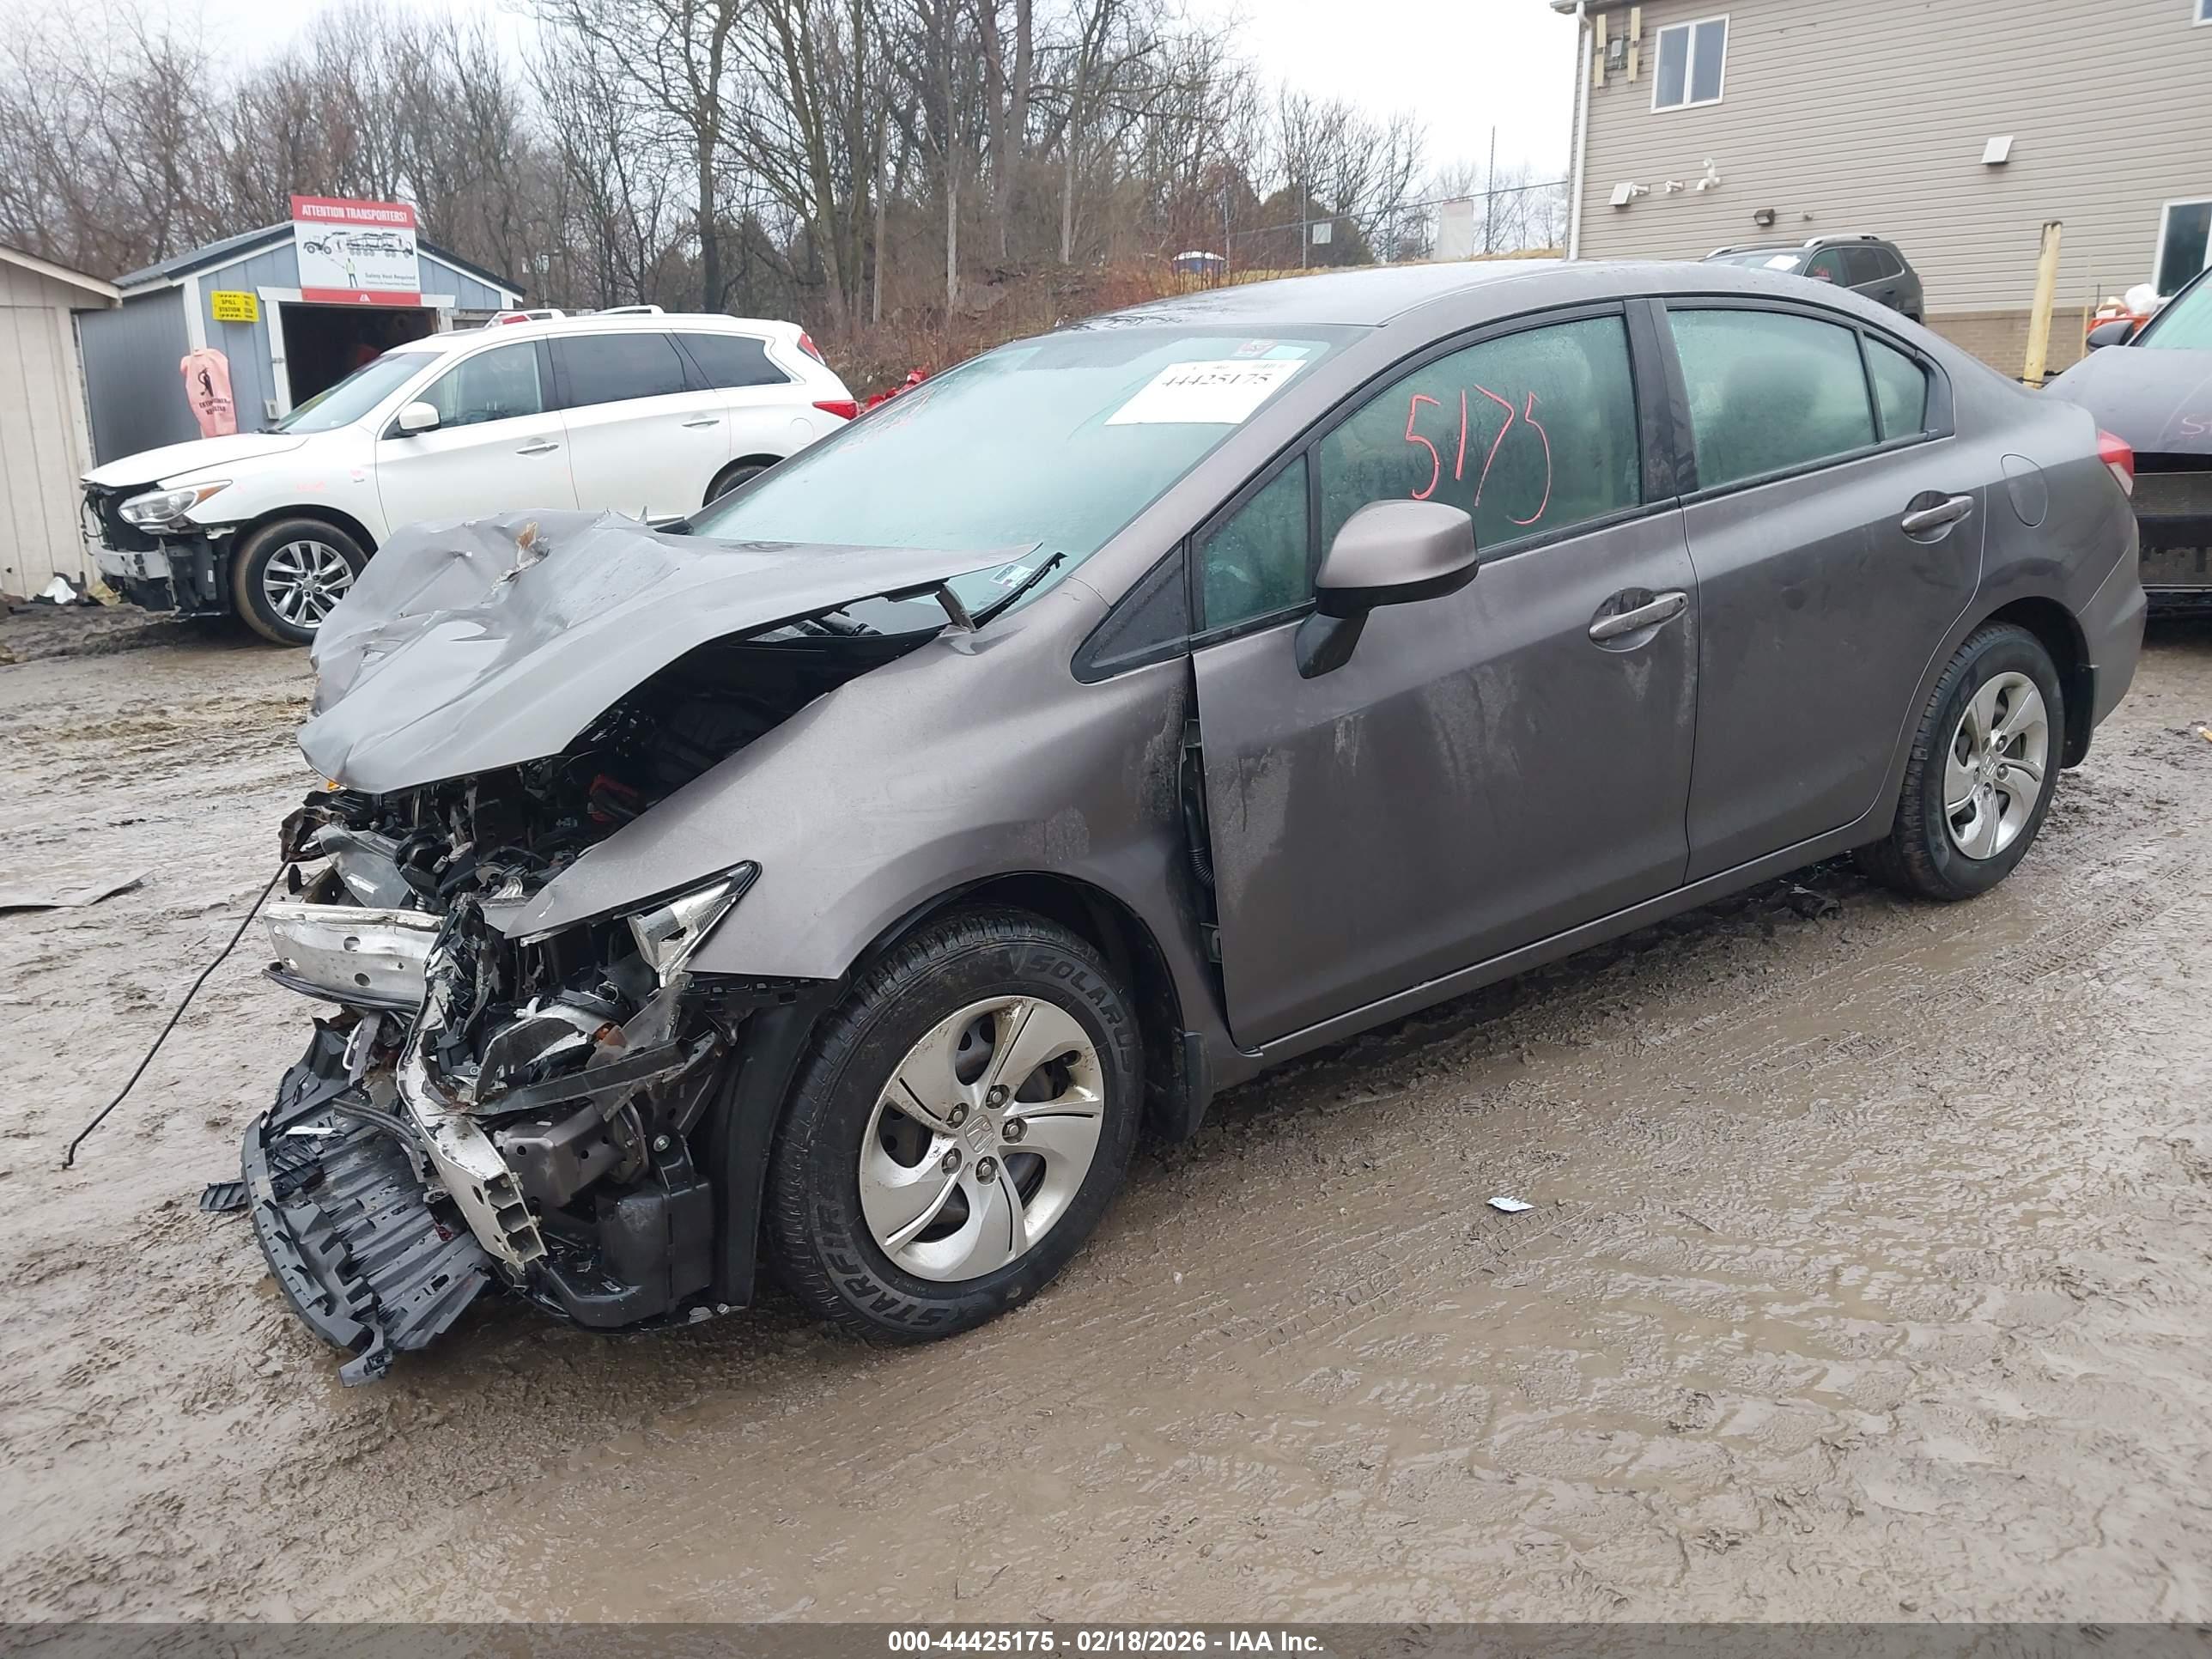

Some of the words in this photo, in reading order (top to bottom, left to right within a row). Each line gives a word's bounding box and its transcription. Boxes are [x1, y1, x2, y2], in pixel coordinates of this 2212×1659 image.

[301, 204, 344, 218] ATTENTION
[345, 207, 408, 222] TRANSPORTERS!
[1405, 383, 1552, 525] 5175
[812, 1185, 950, 1327] STARFIR
